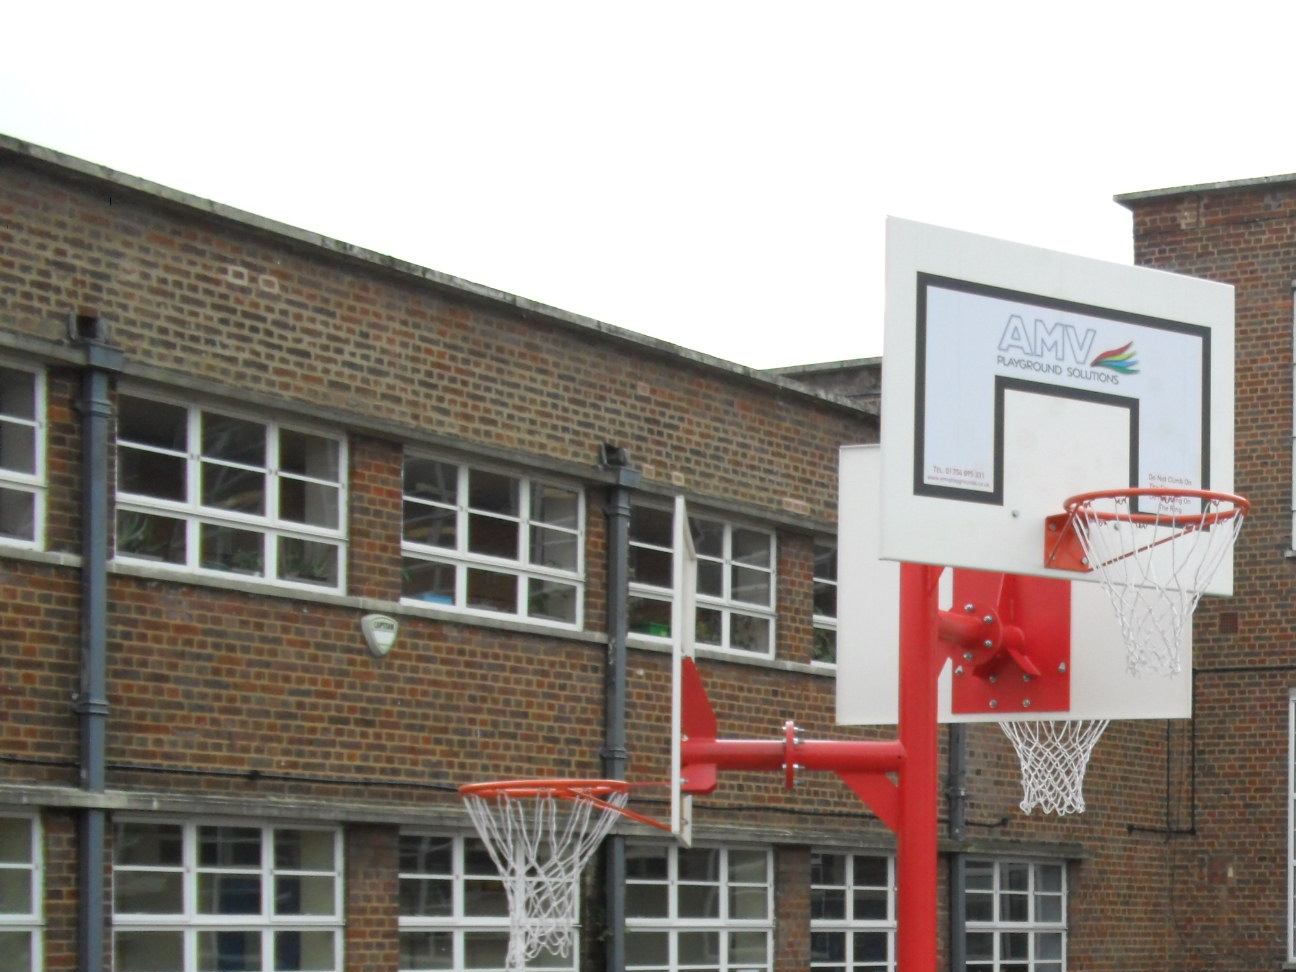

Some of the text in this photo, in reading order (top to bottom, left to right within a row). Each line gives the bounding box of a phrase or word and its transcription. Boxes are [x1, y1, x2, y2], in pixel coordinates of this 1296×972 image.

[998, 314, 1097, 365] AMV
[996, 355, 1120, 385] PLAYGROUND SOLUTIONS
